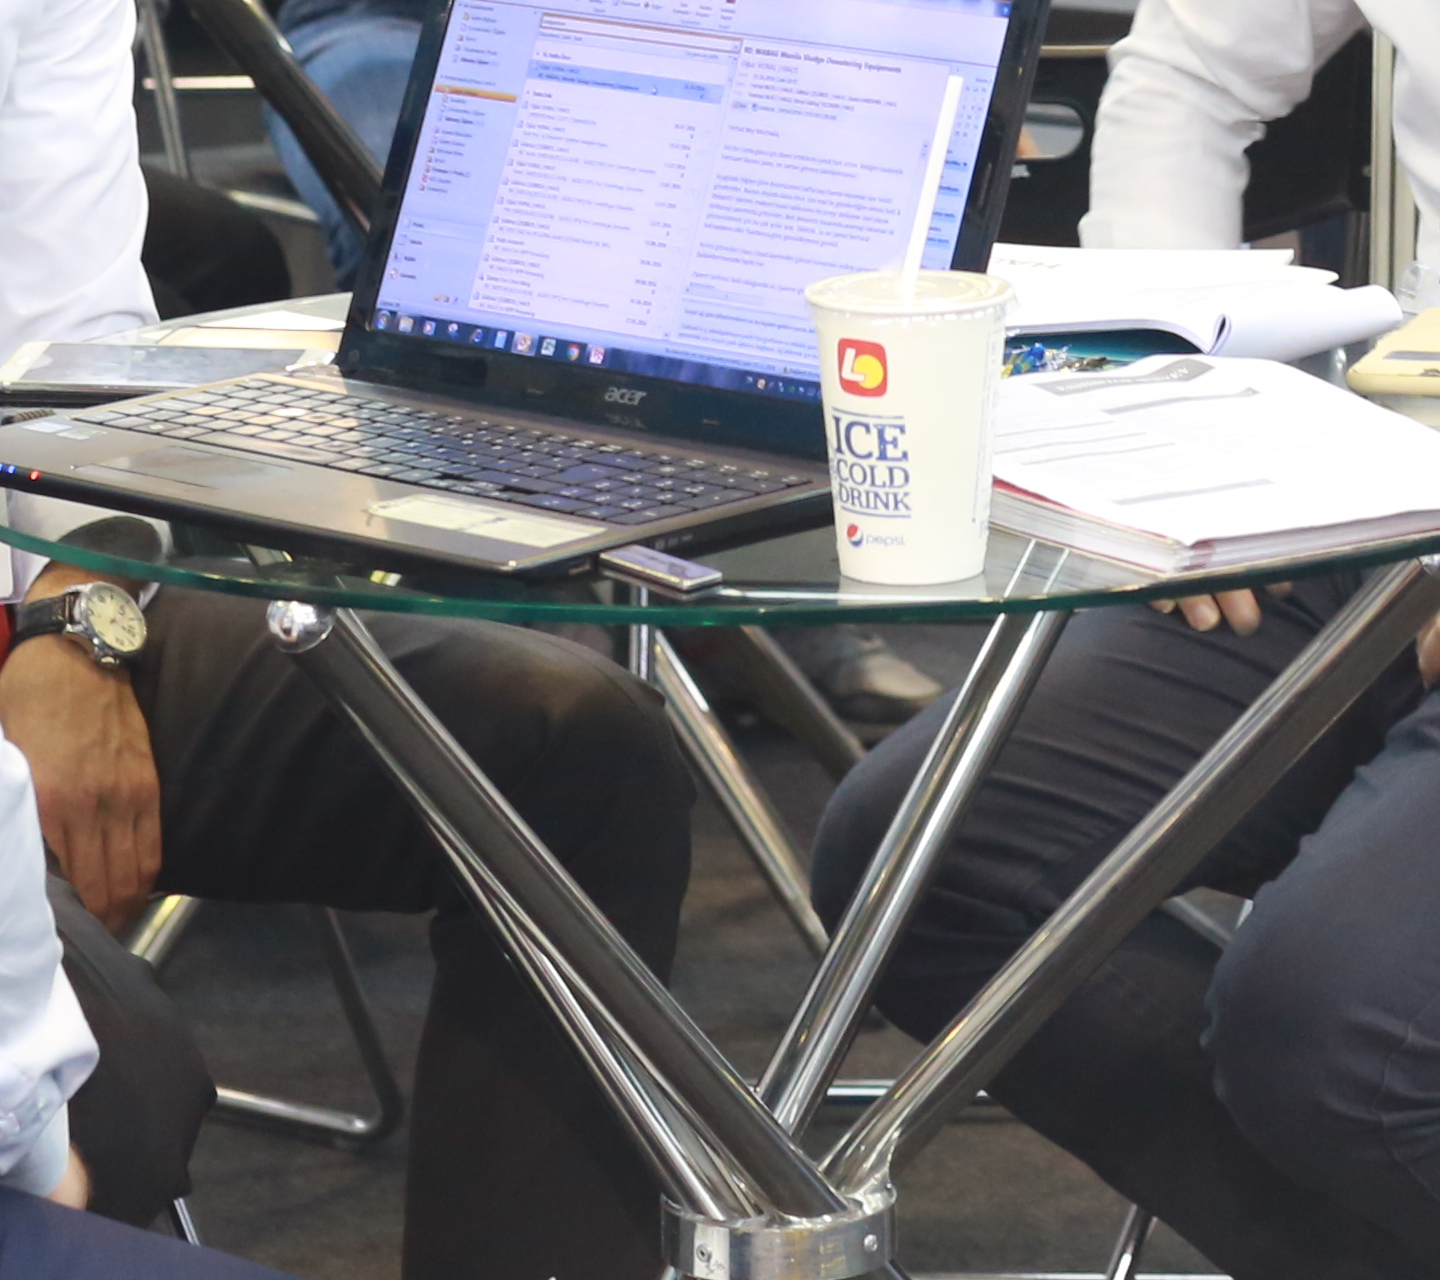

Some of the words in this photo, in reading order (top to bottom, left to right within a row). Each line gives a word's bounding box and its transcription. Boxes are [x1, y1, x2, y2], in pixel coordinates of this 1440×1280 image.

[604, 386, 648, 406] acer
[832, 416, 909, 462] ICE
[836, 458, 910, 490] COLD
[839, 486, 912, 512] DRINK
[865, 531, 906, 547] pepsi
